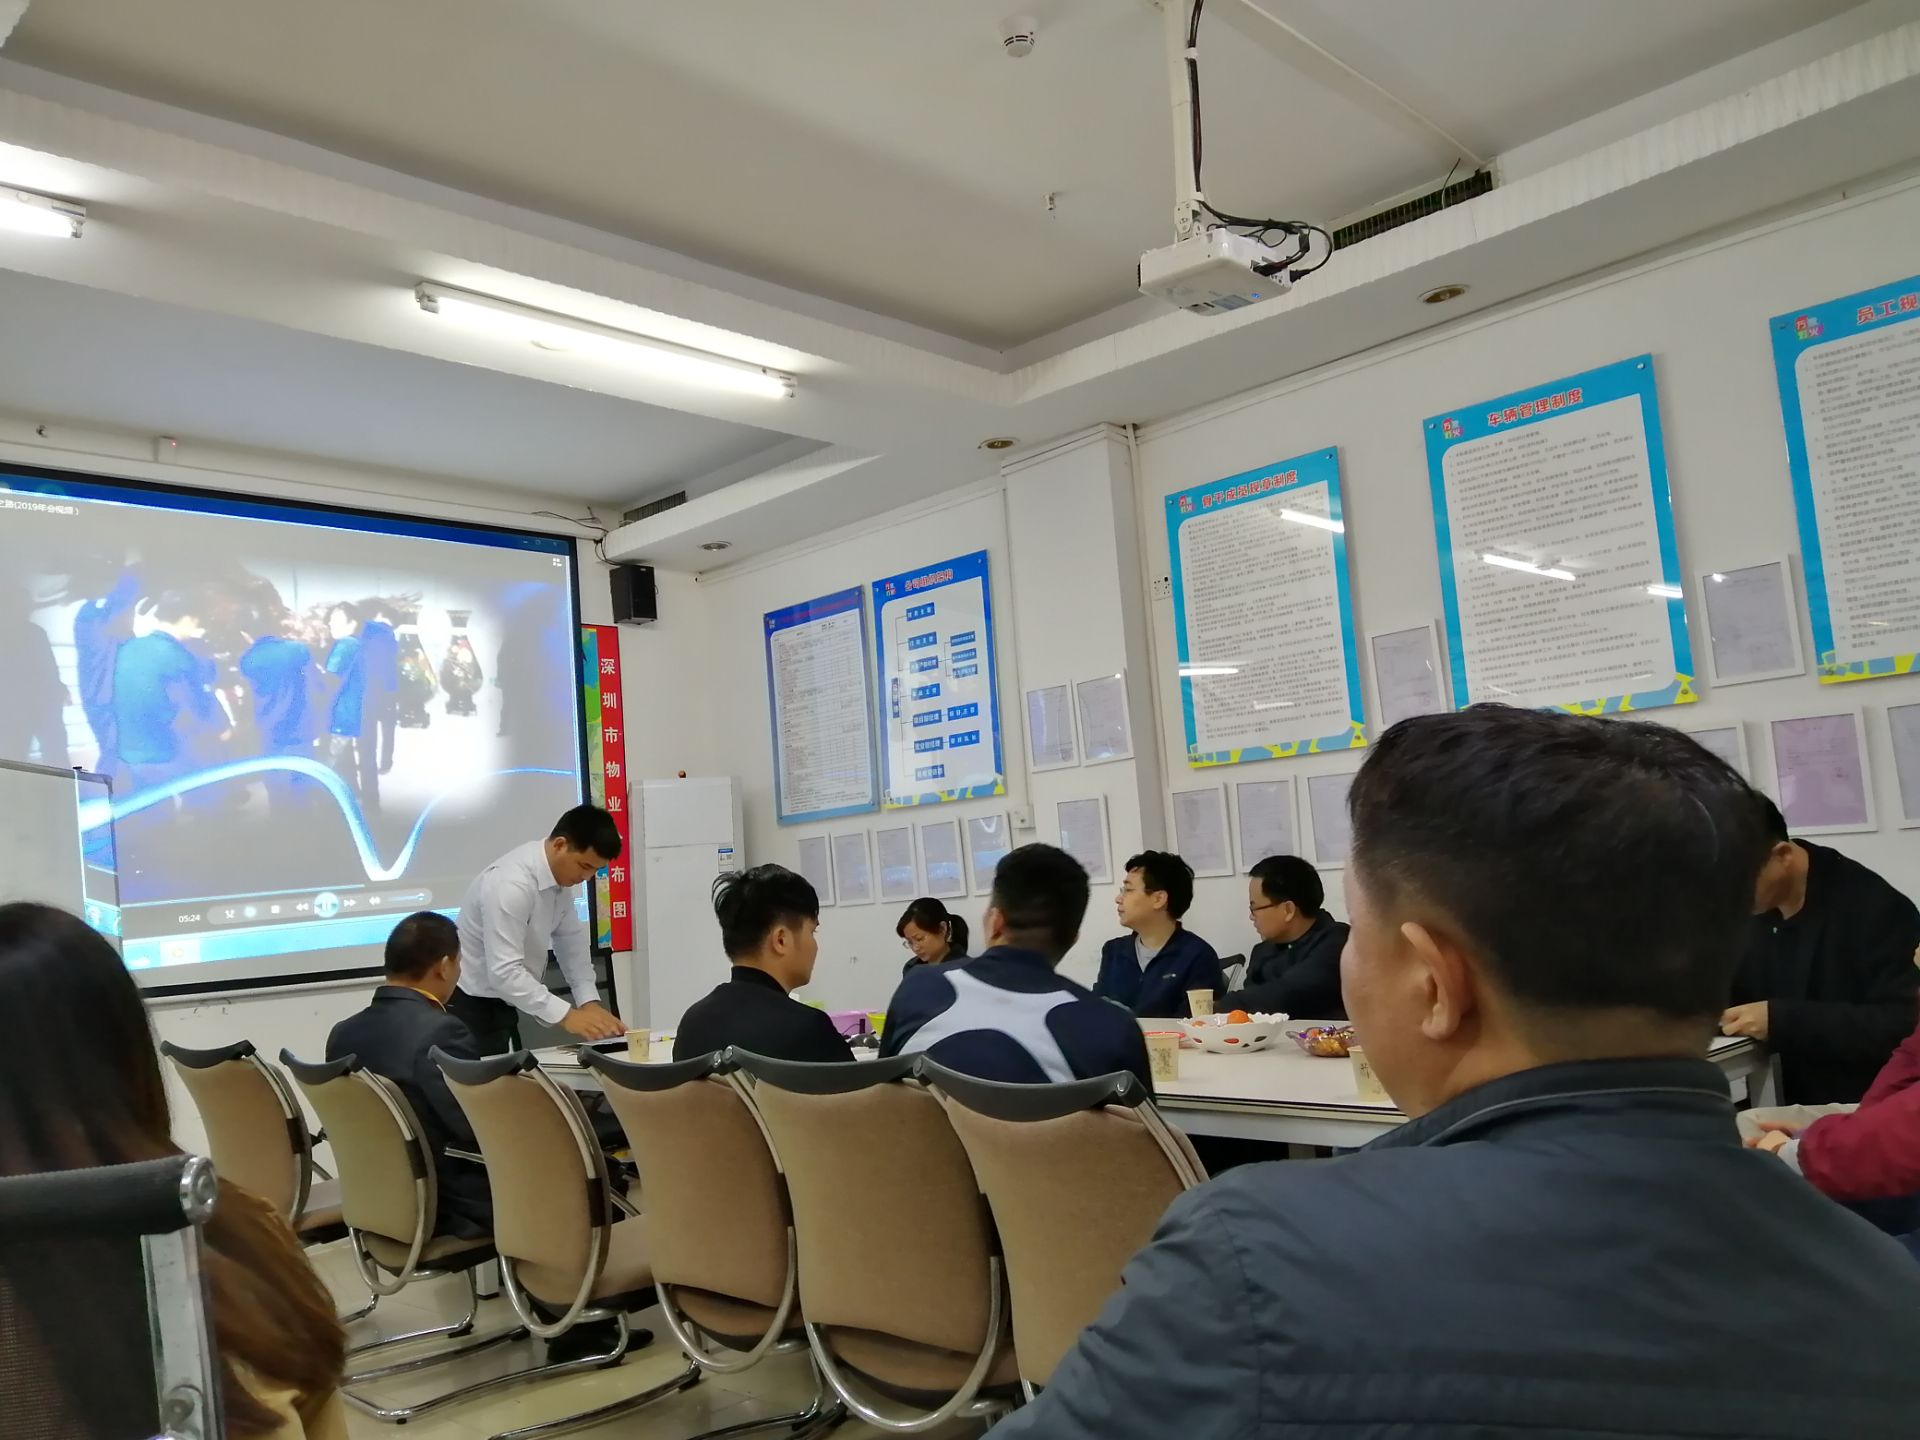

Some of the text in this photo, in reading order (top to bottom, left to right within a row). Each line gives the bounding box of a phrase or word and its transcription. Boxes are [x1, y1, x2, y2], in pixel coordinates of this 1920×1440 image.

[1856, 294, 1918, 325] 员工规
[1487, 387, 1584, 427] 车辆管理制度
[600, 657, 627, 919] 深圳市物业布图
[178, 914, 201, 923] 05:24
